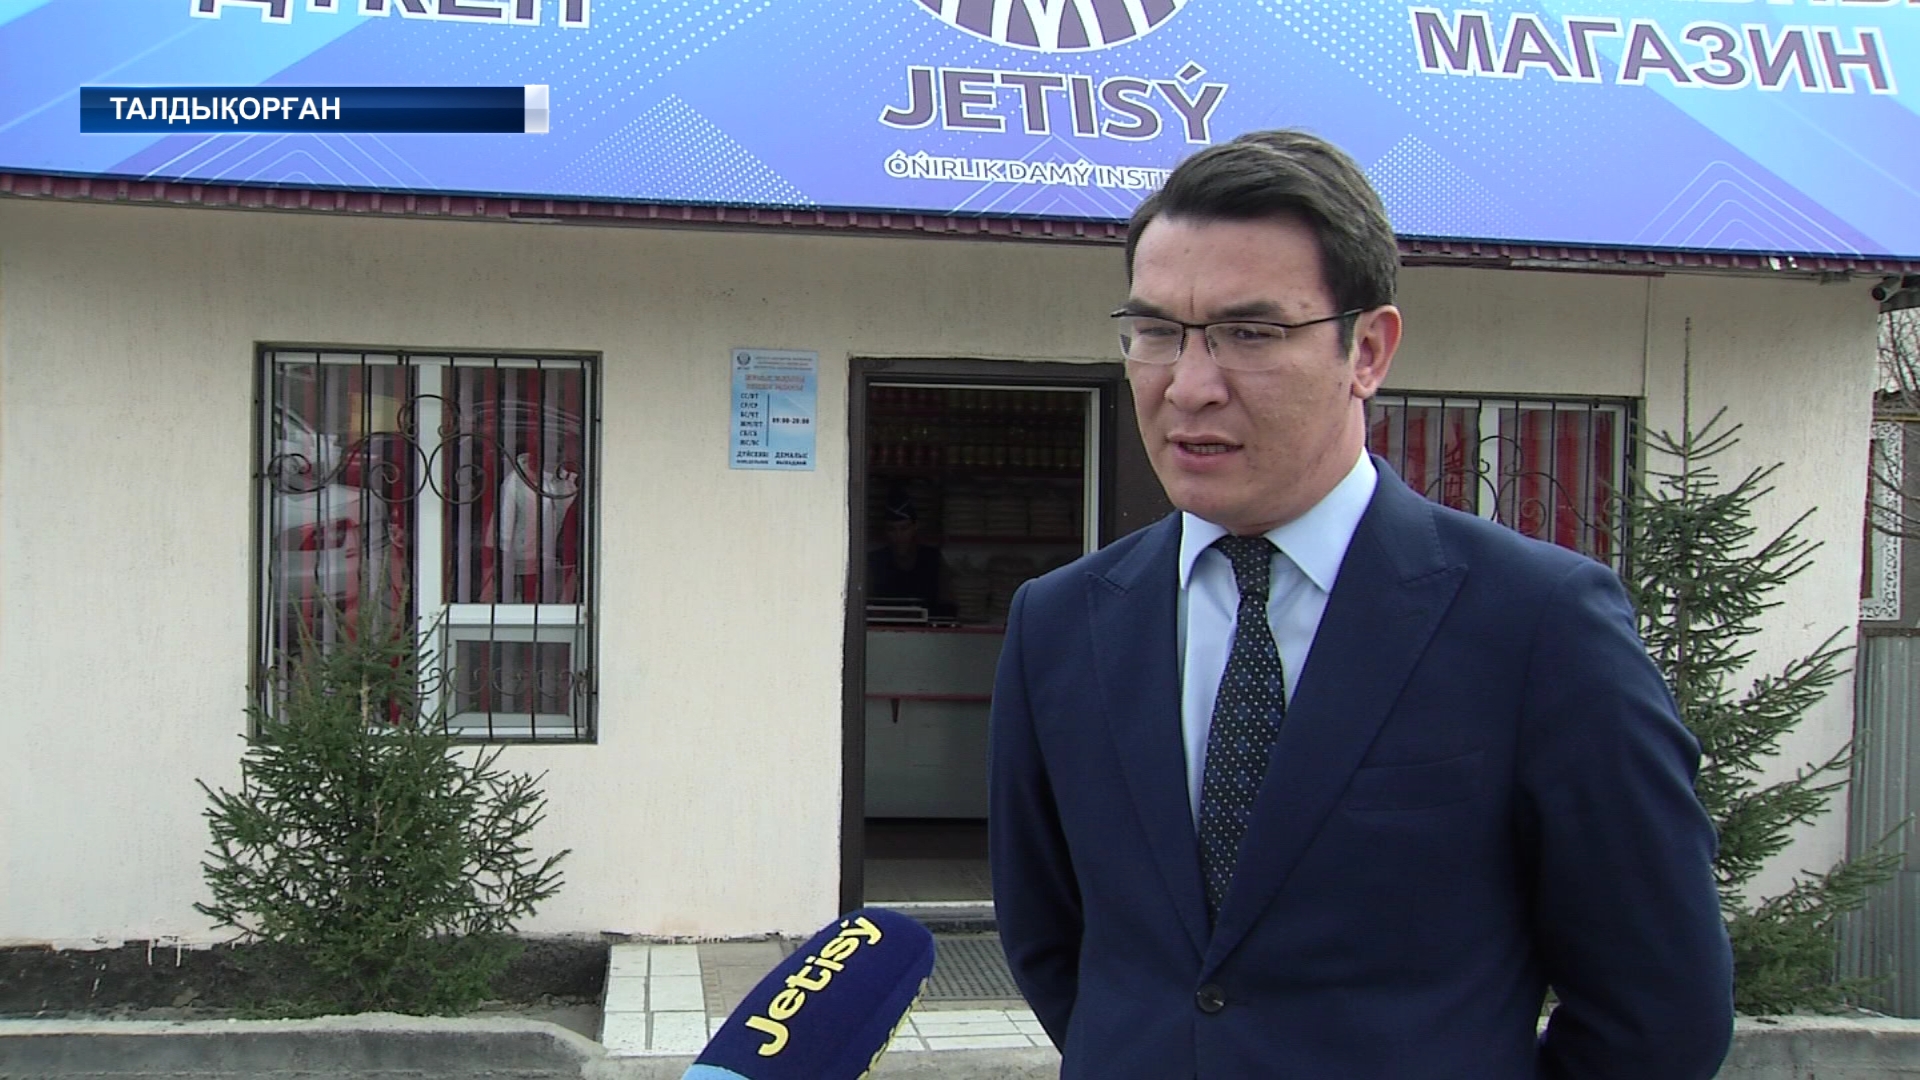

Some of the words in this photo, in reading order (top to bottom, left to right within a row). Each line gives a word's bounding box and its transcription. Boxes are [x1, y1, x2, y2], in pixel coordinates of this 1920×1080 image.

[1409, 7, 1898, 94] МАГАЗИН
[879, 60, 1229, 144] JETISÝ
[1006, 160, 1094, 185] DAMÝ
